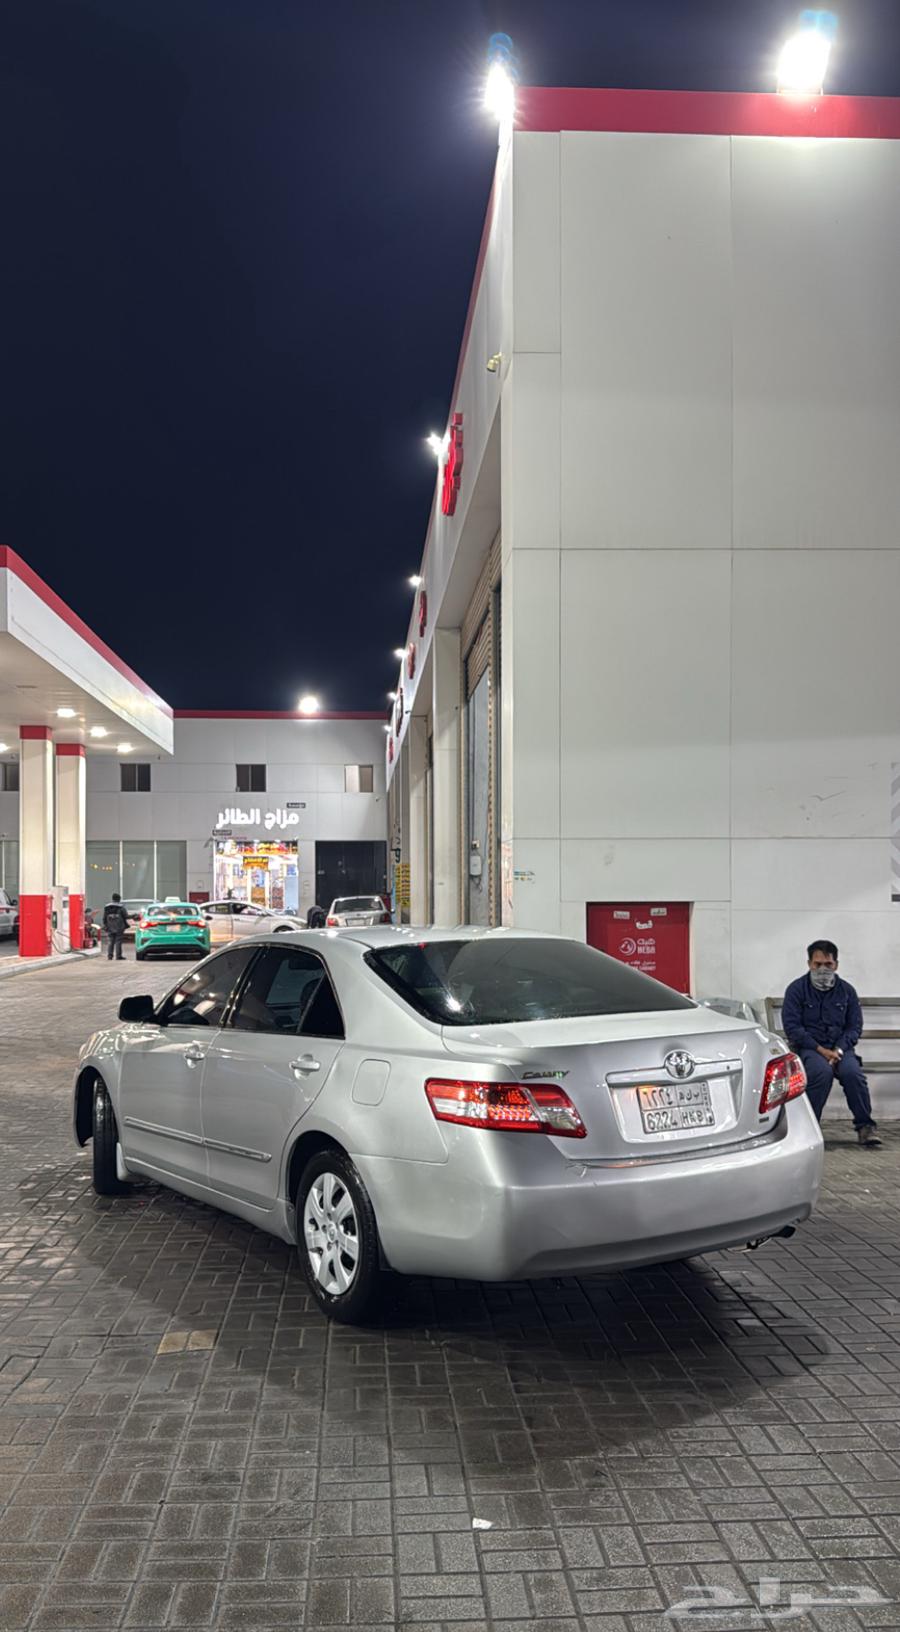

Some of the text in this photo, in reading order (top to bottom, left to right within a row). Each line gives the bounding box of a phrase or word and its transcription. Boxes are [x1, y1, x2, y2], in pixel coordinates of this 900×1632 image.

[215, 808, 299, 829] مزاج الطائر
[646, 1109, 678, 1131] 6224
